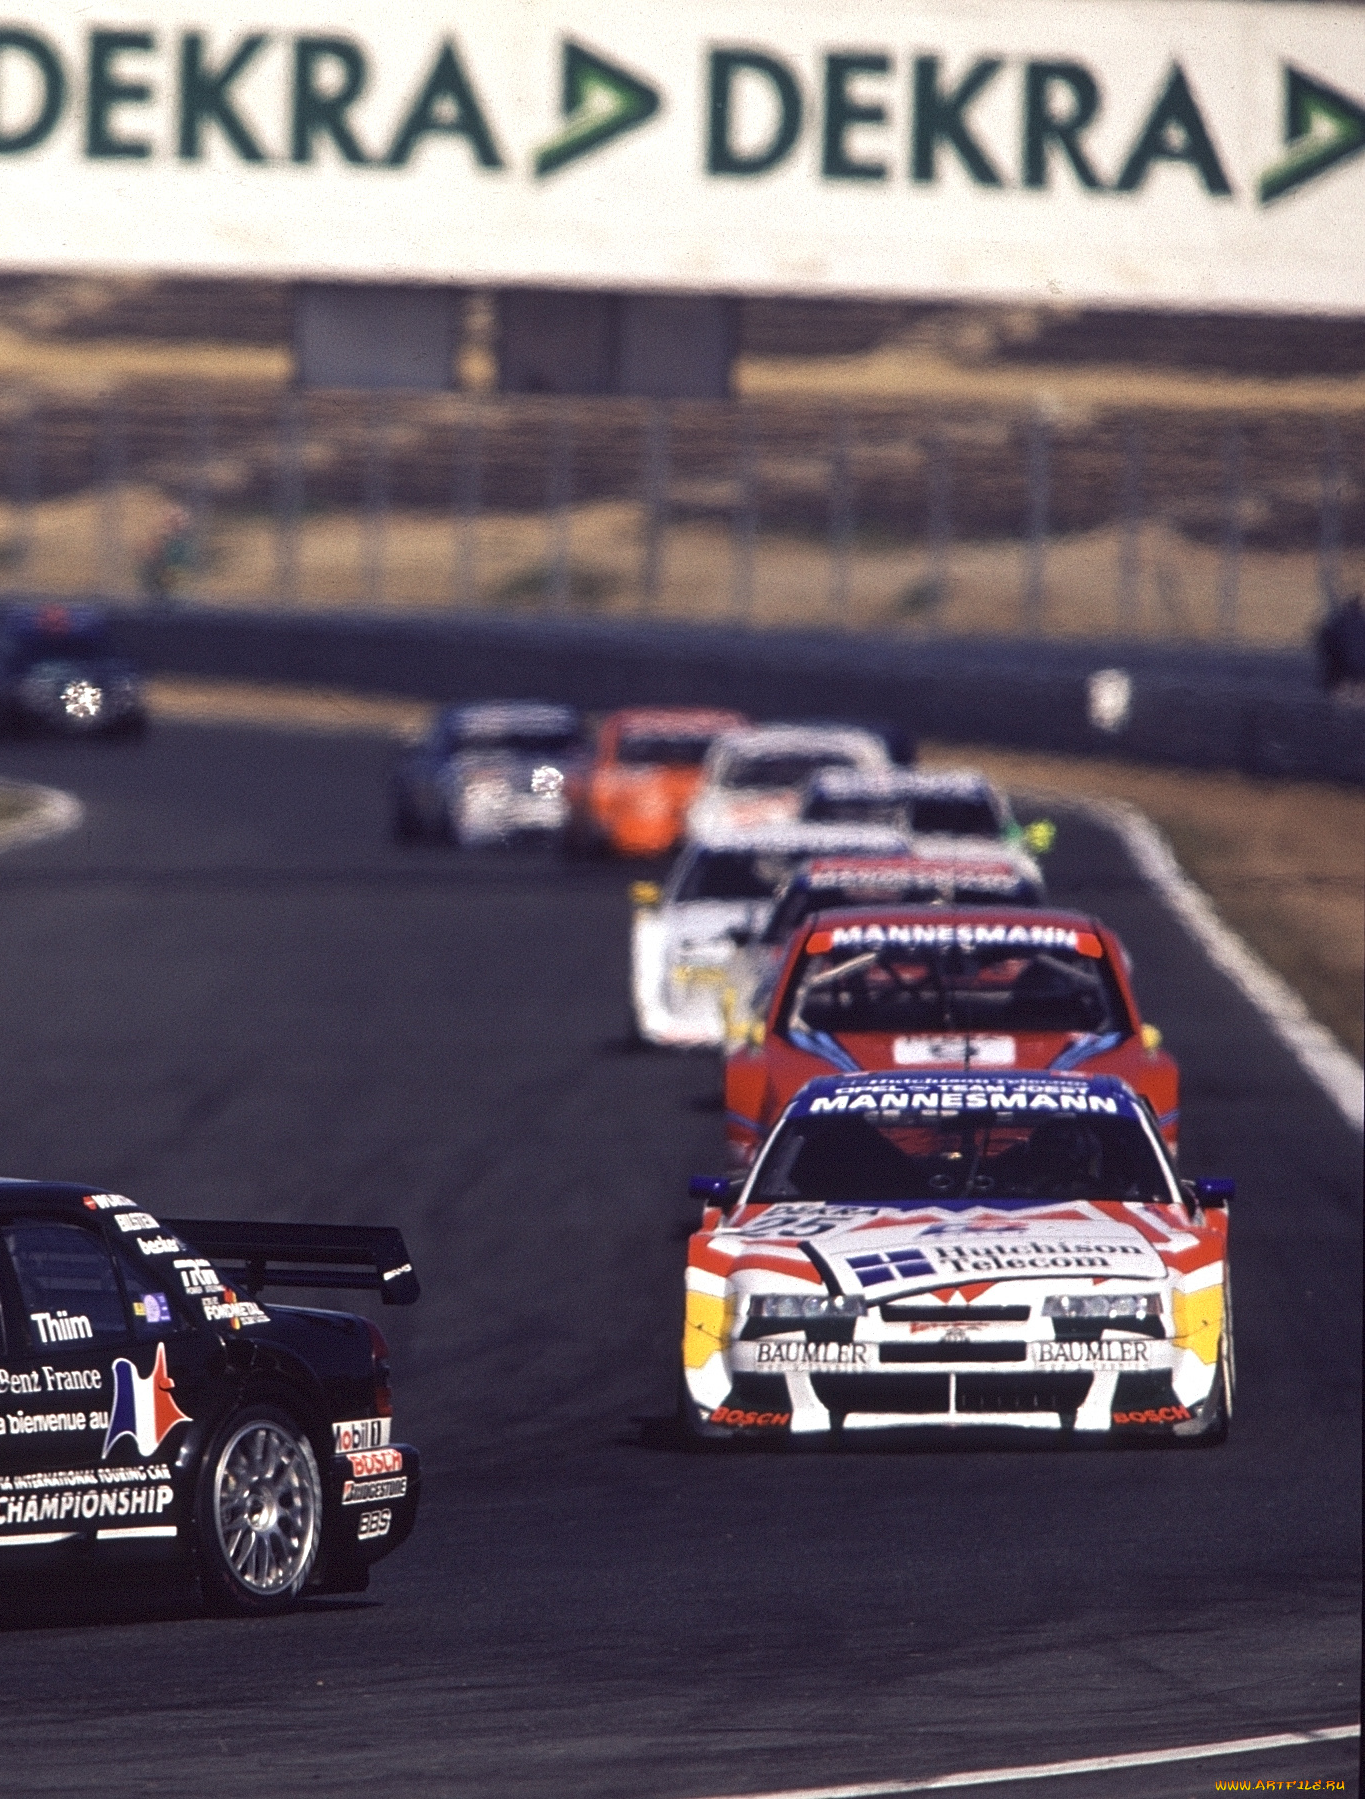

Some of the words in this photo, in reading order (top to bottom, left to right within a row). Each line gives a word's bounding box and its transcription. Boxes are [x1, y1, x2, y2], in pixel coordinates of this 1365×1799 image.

[705, 40, 1233, 199] DEKRA
[832, 926, 1078, 943] MANNESMANN
[937, 1084, 1005, 1093] TEAM
[809, 1093, 1117, 1113] MANNESMANN
[745, 1216, 837, 1237] 25
[935, 1242, 1146, 1259] Hutchison
[939, 1256, 1111, 1273] Telecom
[31, 1310, 93, 1342] Thiim
[41, 1366, 103, 1391] France
[7, 1410, 87, 1435] bienvenue
[89, 1411, 108, 1429] au
[710, 1405, 789, 1426] BOSCH
[1113, 1405, 1191, 1424] BOSCH
[352, 1451, 401, 1476] BOSCH
[14, 1470, 98, 1489] INTERNATIONAL
[96, 1466, 147, 1484] TOURING
[146, 1464, 172, 1480] CAR
[358, 1509, 391, 1539] BBS
